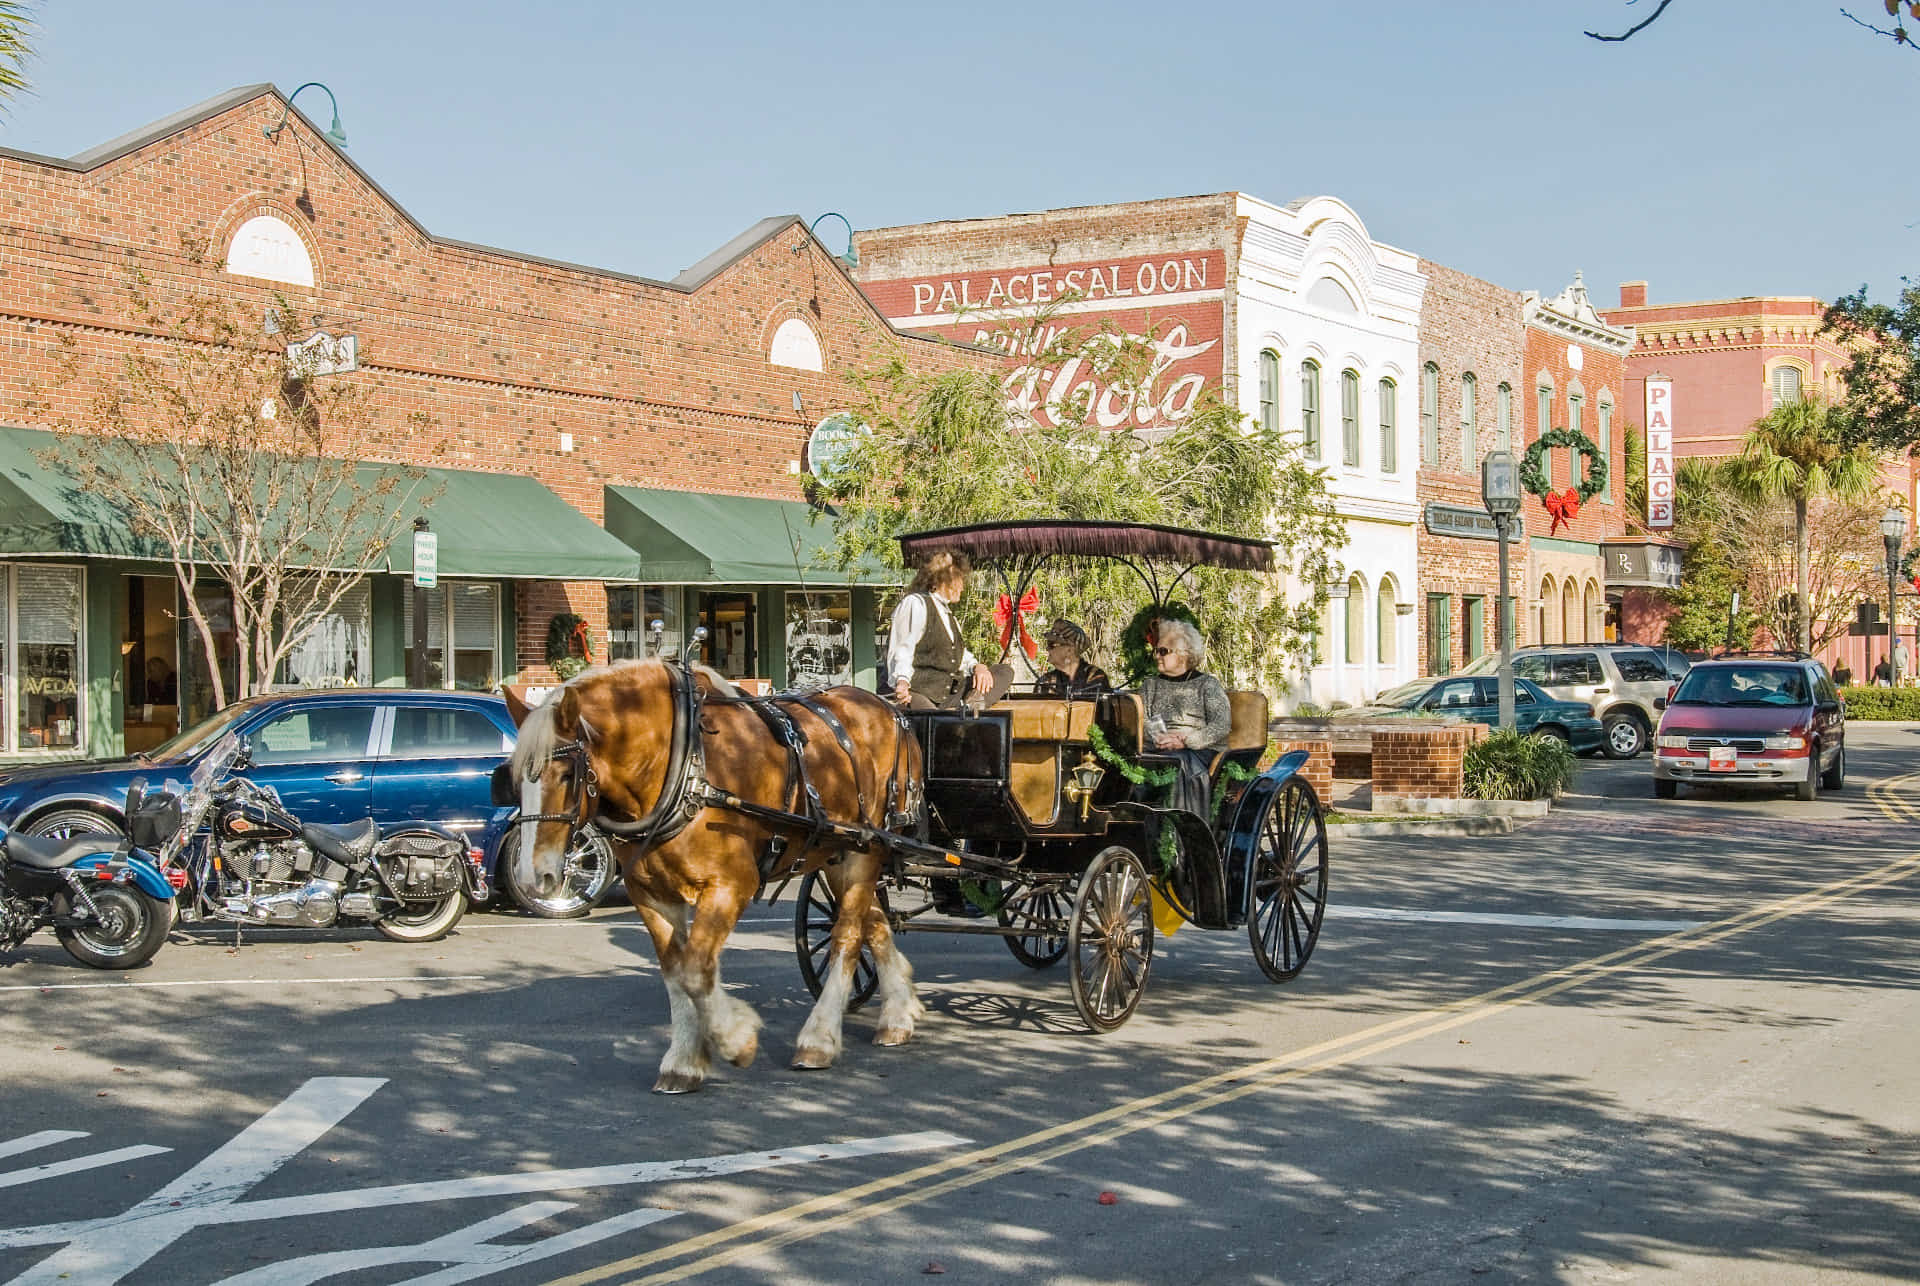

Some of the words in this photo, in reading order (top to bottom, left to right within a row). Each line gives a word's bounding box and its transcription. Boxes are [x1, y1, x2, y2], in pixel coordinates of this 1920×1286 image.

[911, 271, 1054, 315] PALACE
[1065, 257, 1208, 300] SALOON
[1650, 387, 1669, 521] PALACE
[21, 677, 77, 694] AVEDA
